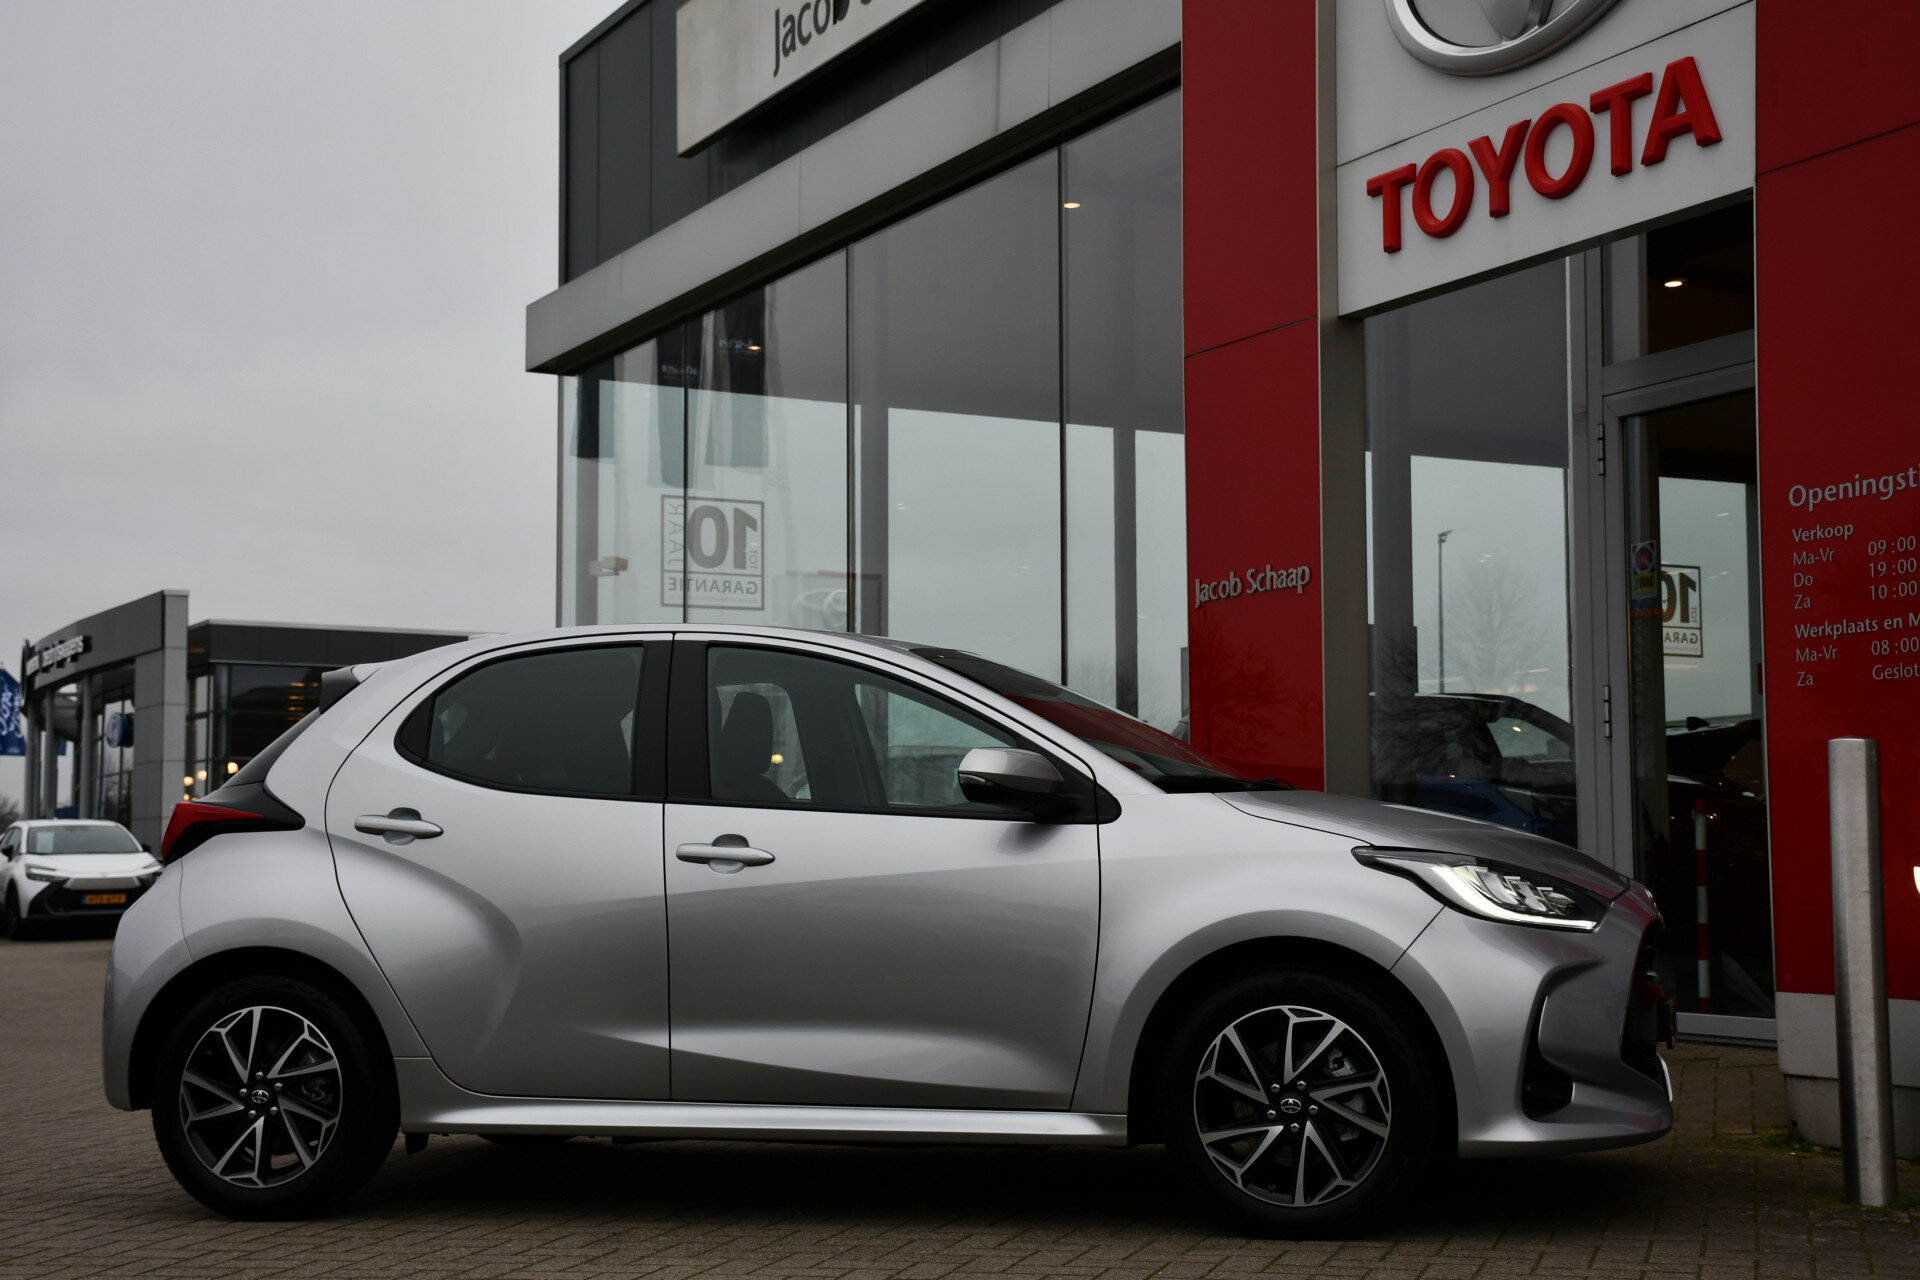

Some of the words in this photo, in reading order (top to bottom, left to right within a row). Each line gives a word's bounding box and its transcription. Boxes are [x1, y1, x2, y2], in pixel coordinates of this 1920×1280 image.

[1366, 56, 1722, 254] TOYOTA
[1788, 463, 1920, 512] Openingst
[1791, 524, 1854, 543] Verkoop
[1793, 548, 1835, 566] Ma-Vr
[1195, 571, 1243, 609] Jacob
[1246, 564, 1311, 594] Schaap
[1794, 572, 1814, 588] Do
[1794, 594, 1811, 610] Za
[1795, 618, 1879, 640] Werkplaats
[1884, 617, 1903, 630] en
[1796, 645, 1838, 663] Ma-Vr
[1797, 671, 1814, 687] Za
[1871, 662, 1920, 681] Geslot
